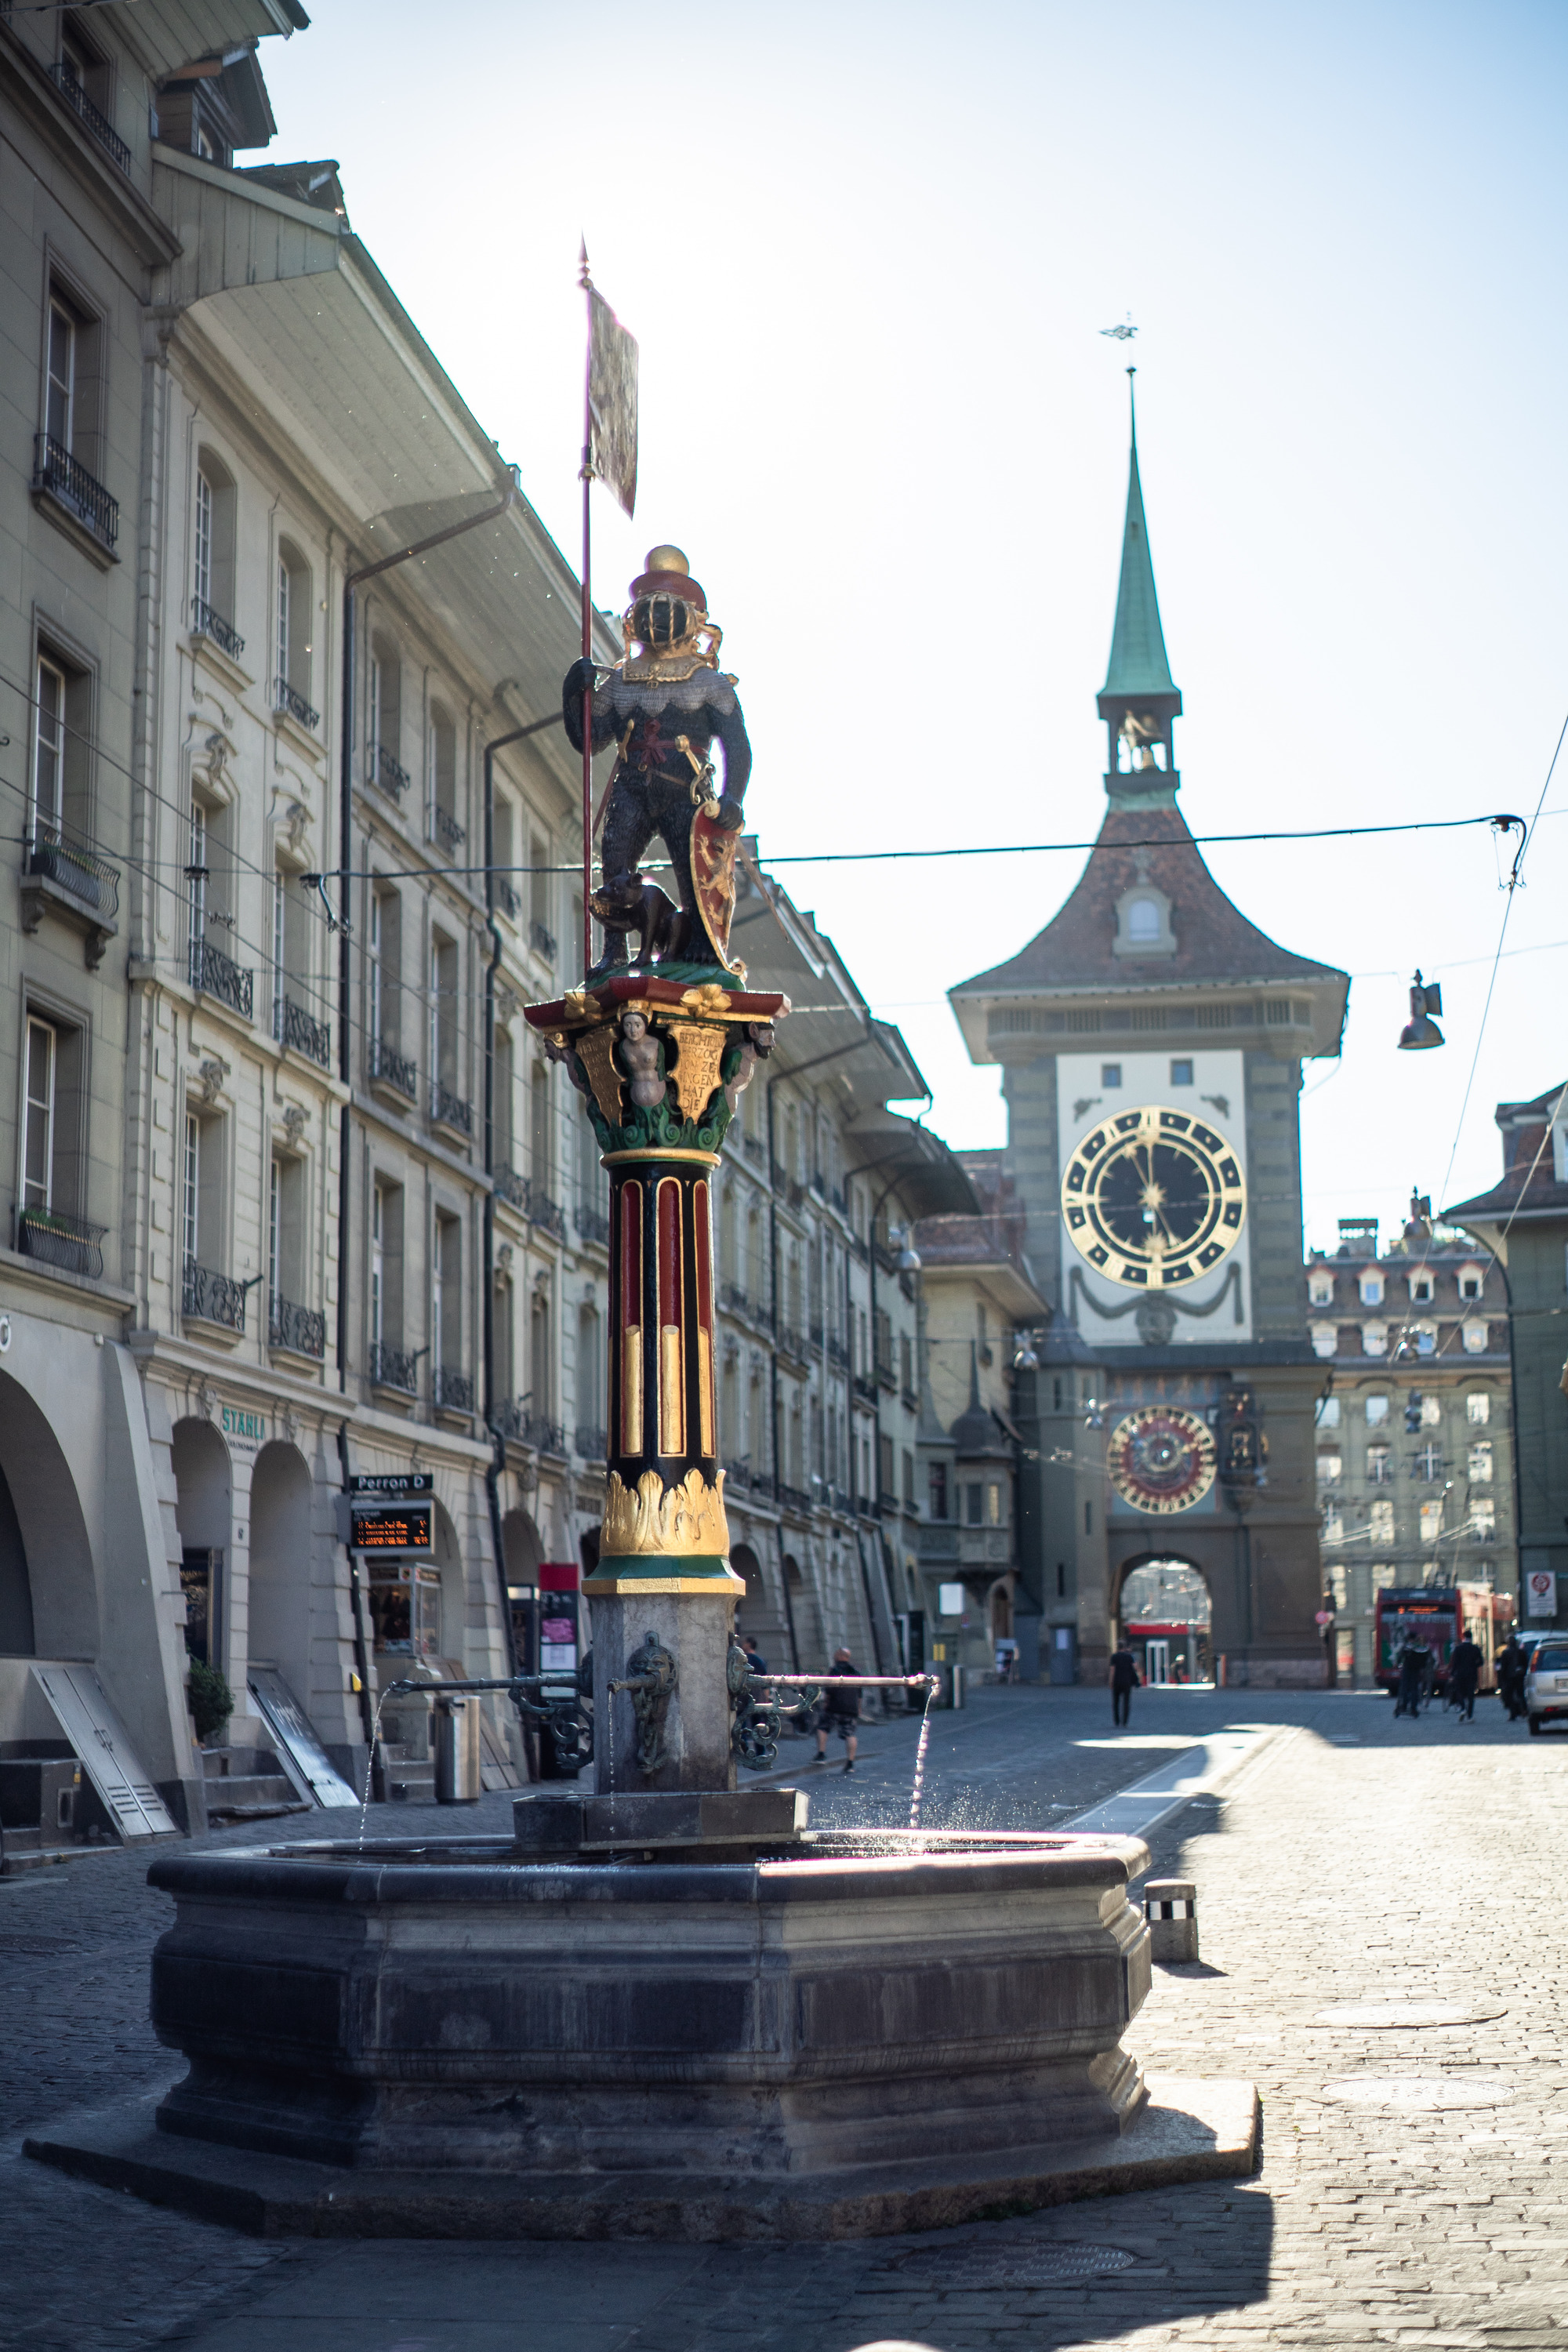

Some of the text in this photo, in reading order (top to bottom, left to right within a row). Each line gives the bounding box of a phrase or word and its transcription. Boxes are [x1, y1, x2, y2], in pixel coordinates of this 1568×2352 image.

[682, 1084, 705, 1098] HAT
[681, 1098, 700, 1110] DIE
[358, 1474, 425, 1490] Perron D
